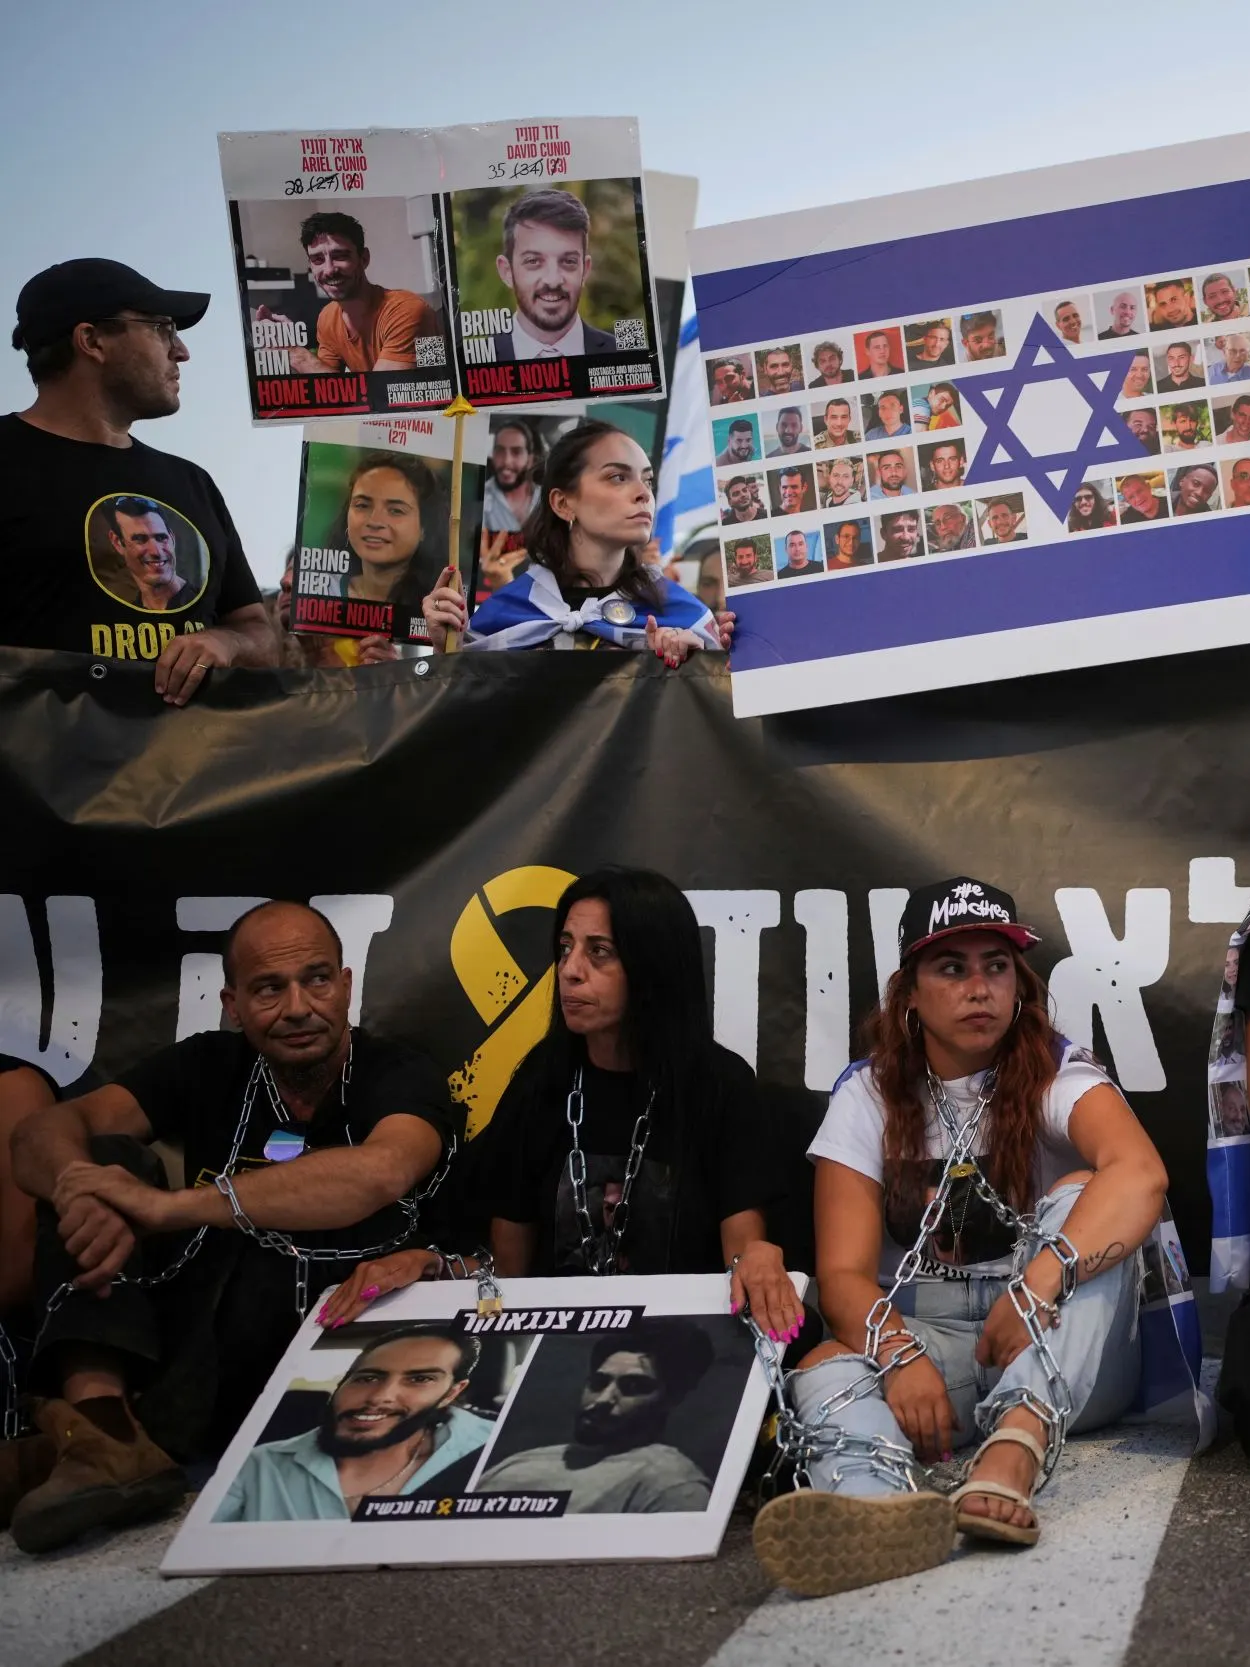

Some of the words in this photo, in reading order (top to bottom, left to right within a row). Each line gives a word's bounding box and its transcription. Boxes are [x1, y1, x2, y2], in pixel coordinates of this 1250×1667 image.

[328, 137, 364, 154] אריאל
[507, 143, 538, 160] DAVID
[540, 140, 571, 158] CUNIO
[302, 156, 333, 172] ARIEL
[334, 155, 367, 172] CUNIO
[487, 162, 507, 179] 35
[285, 178, 304, 196] 28
[460, 308, 513, 337] BRING
[251, 321, 308, 349] BRING
[462, 337, 497, 364] HIM
[254, 349, 291, 376] HIM
[588, 366, 615, 377] HOSTAGES
[616, 365, 627, 374] AND
[627, 363, 651, 374] MISSING
[466, 365, 517, 395] HOME
[519, 357, 571, 390] NOW!
[590, 375, 624, 389] FAMILIES
[625, 372, 653, 386] FORUM
[257, 378, 310, 407] HOME
[313, 373, 368, 404] NOW!
[386, 382, 415, 392] HOSTAGES
[416, 381, 427, 390] AND
[427, 379, 451, 390] MISSING
[388, 390, 424, 405] FAMILIES
[424, 387, 453, 402] FORUM
[394, 419, 434, 435] HAYMAN
[388, 428, 407, 446] (27)
[300, 547, 350, 574] BRING
[298, 571, 330, 597] HER
[296, 598, 343, 624] HOME
[346, 602, 393, 630] NOW!
[91, 622, 176, 660] DROP
[577, 1309, 633, 1332] מתן
[415, 1500, 437, 1514] זה
[456, 1499, 483, 1513] עוד
[484, 1497, 509, 1513] לא
